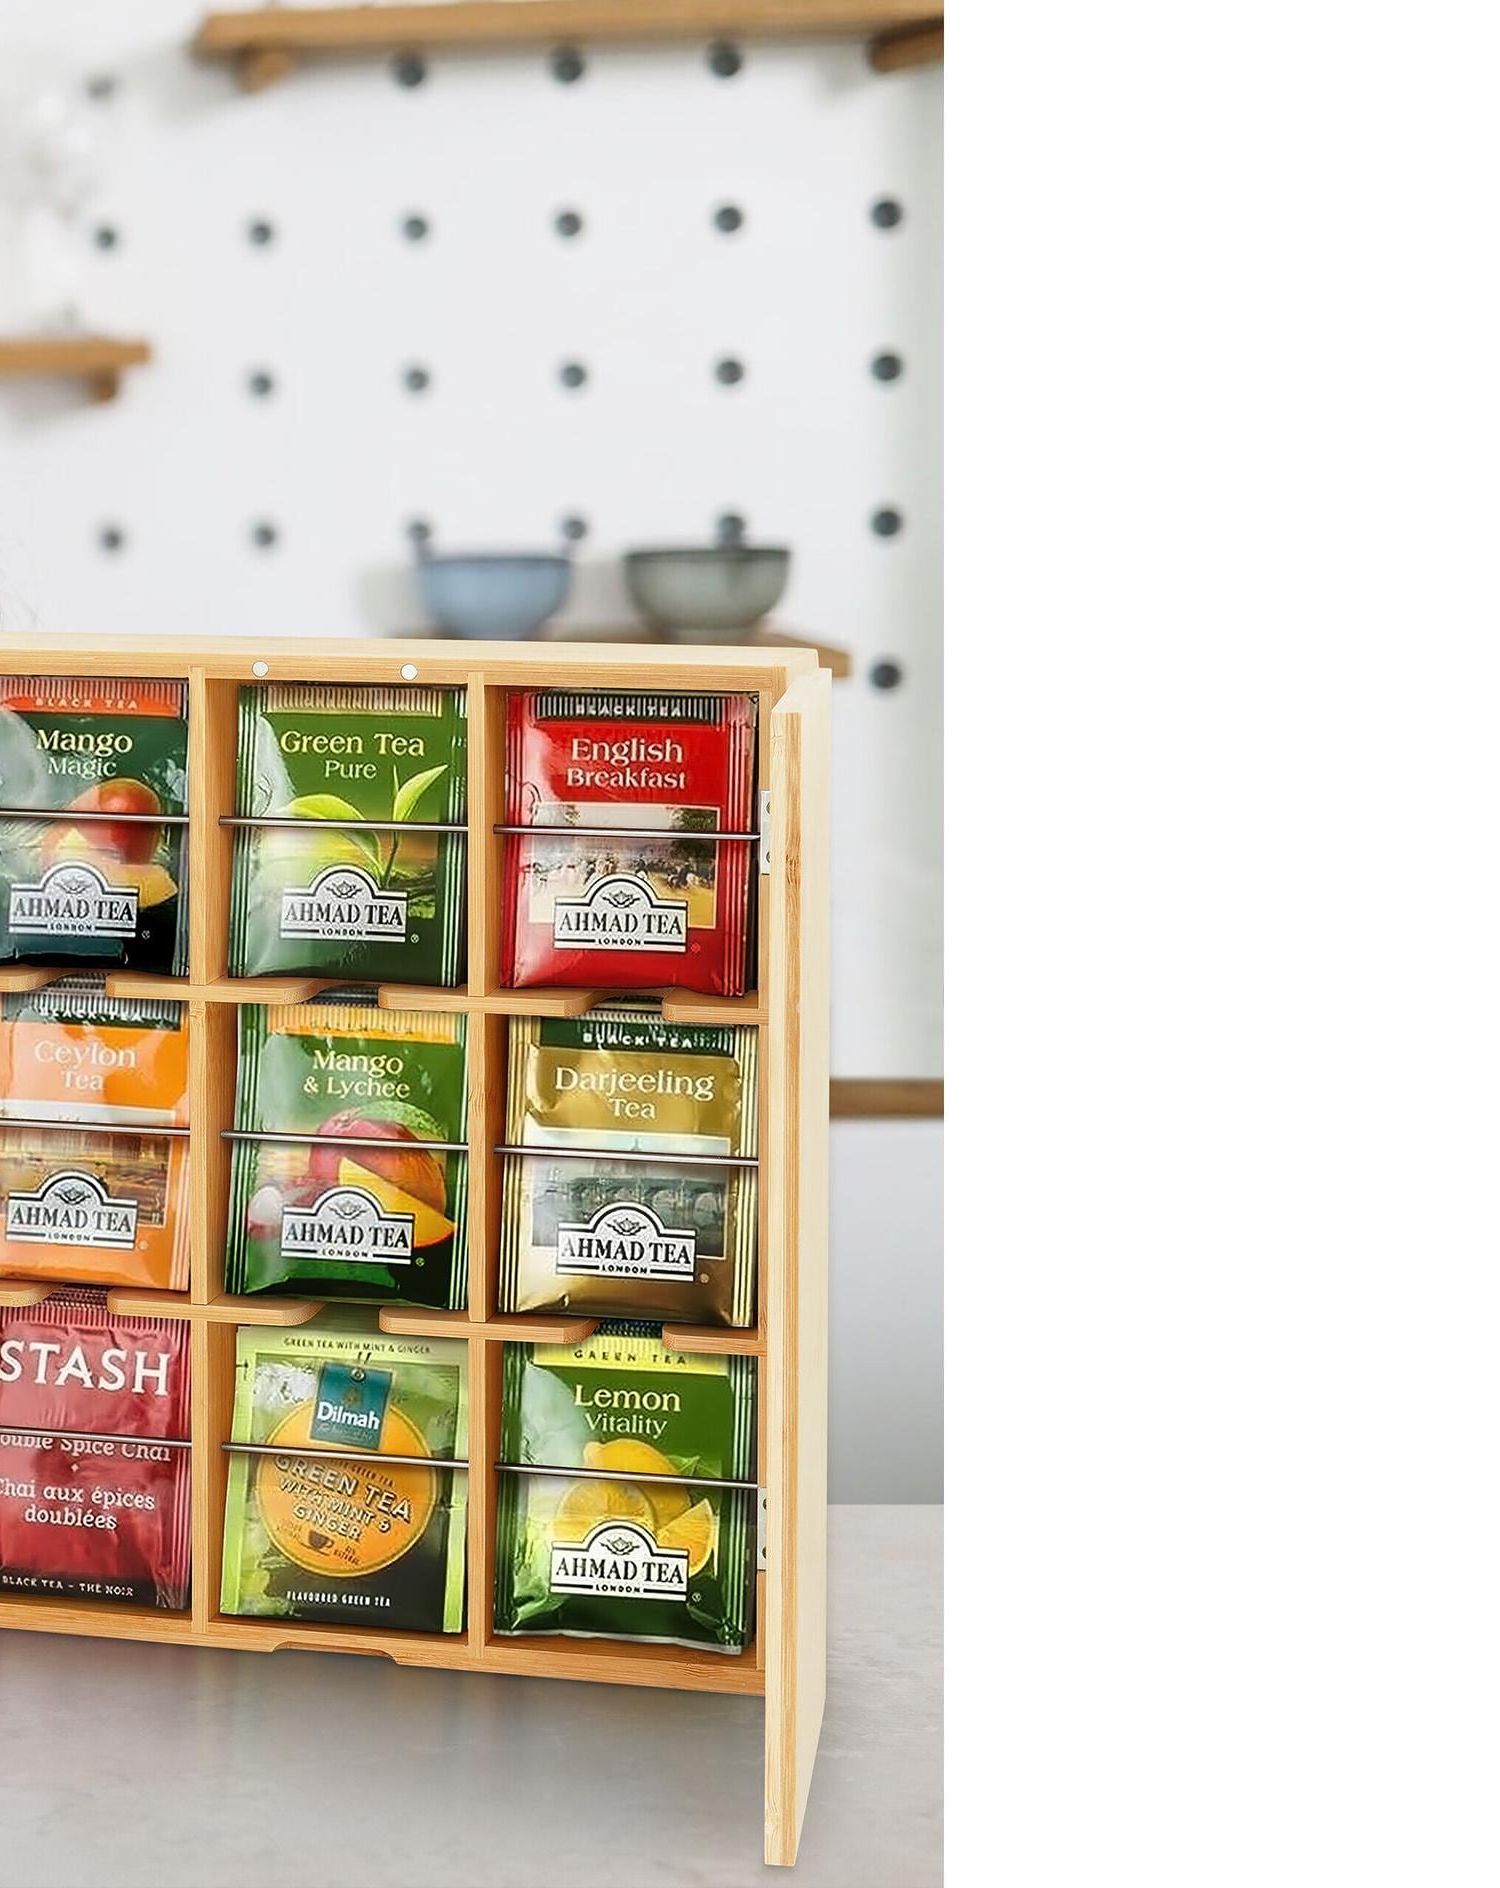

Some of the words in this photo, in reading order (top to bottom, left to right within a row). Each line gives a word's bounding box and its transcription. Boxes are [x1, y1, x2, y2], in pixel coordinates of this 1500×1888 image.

[104, 699, 137, 710] TEA
[35, 729, 133, 757] Mango
[280, 730, 363, 754] Green
[373, 733, 425, 757] Tea
[571, 737, 683, 767] English
[47, 756, 117, 780] Magic
[324, 760, 377, 779] Pure
[566, 767, 687, 790] Breakfast
[13, 897, 90, 919] AHMAD
[93, 900, 134, 922] TEA
[284, 902, 361, 924] AHMAD
[364, 904, 404, 926] TEA
[49, 922, 93, 932] LONDON
[321, 929, 364, 937] LONDON
[559, 911, 638, 933] AHMAD
[642, 914, 683, 935] TEA
[597, 938, 642, 946] LONDON
[33, 1039, 137, 1068] Ceylon
[312, 1049, 404, 1078] Mango
[61, 1071, 104, 1090] Tea
[303, 1077, 320, 1094] &
[327, 1077, 411, 1099] Lychee
[555, 1066, 715, 1101] Darjeeling
[608, 1098, 657, 1120] Tea
[11, 1207, 88, 1229] AHMAD
[91, 1210, 132, 1233] TEA
[47, 1233, 91, 1242] LONDON
[285, 1222, 364, 1246] AHMAD
[368, 1226, 410, 1249] TEA
[321, 1249, 369, 1258] LONDON
[561, 1237, 645, 1262] AHMAD
[648, 1241, 692, 1265] TEA
[601, 1265, 649, 1275] LONDON
[283, 1337, 314, 1347] GREEN
[317, 1338, 334, 1348] TEA
[336, 1340, 360, 1350] WITH
[363, 1342, 385, 1351] MINT
[397, 1345, 431, 1354] GINGER
[574, 1349, 637, 1363] GREEN
[652, 1353, 688, 1366] TEA
[573, 1383, 682, 1413] Lemon
[316, 1401, 380, 1431] Dilmah
[585, 1412, 669, 1439] Vitality
[60, 1437, 115, 1457] Spice
[121, 1443, 172, 1462] Chai
[43, 1485, 84, 1503] aux
[91, 1485, 156, 1511] épices
[275, 1455, 359, 1498] GREEN
[365, 1484, 411, 1524] TEA
[24, 1504, 118, 1531] doublées
[293, 1503, 362, 1542] GINGER
[329, 1498, 376, 1527] MINT
[556, 1557, 638, 1580] AHMAD
[642, 1561, 685, 1585] TEA
[2, 1575, 37, 1587] BLACK
[41, 1578, 64, 1590] TEA
[104, 1584, 134, 1597] NOIR
[595, 1584, 641, 1594] LONDON
